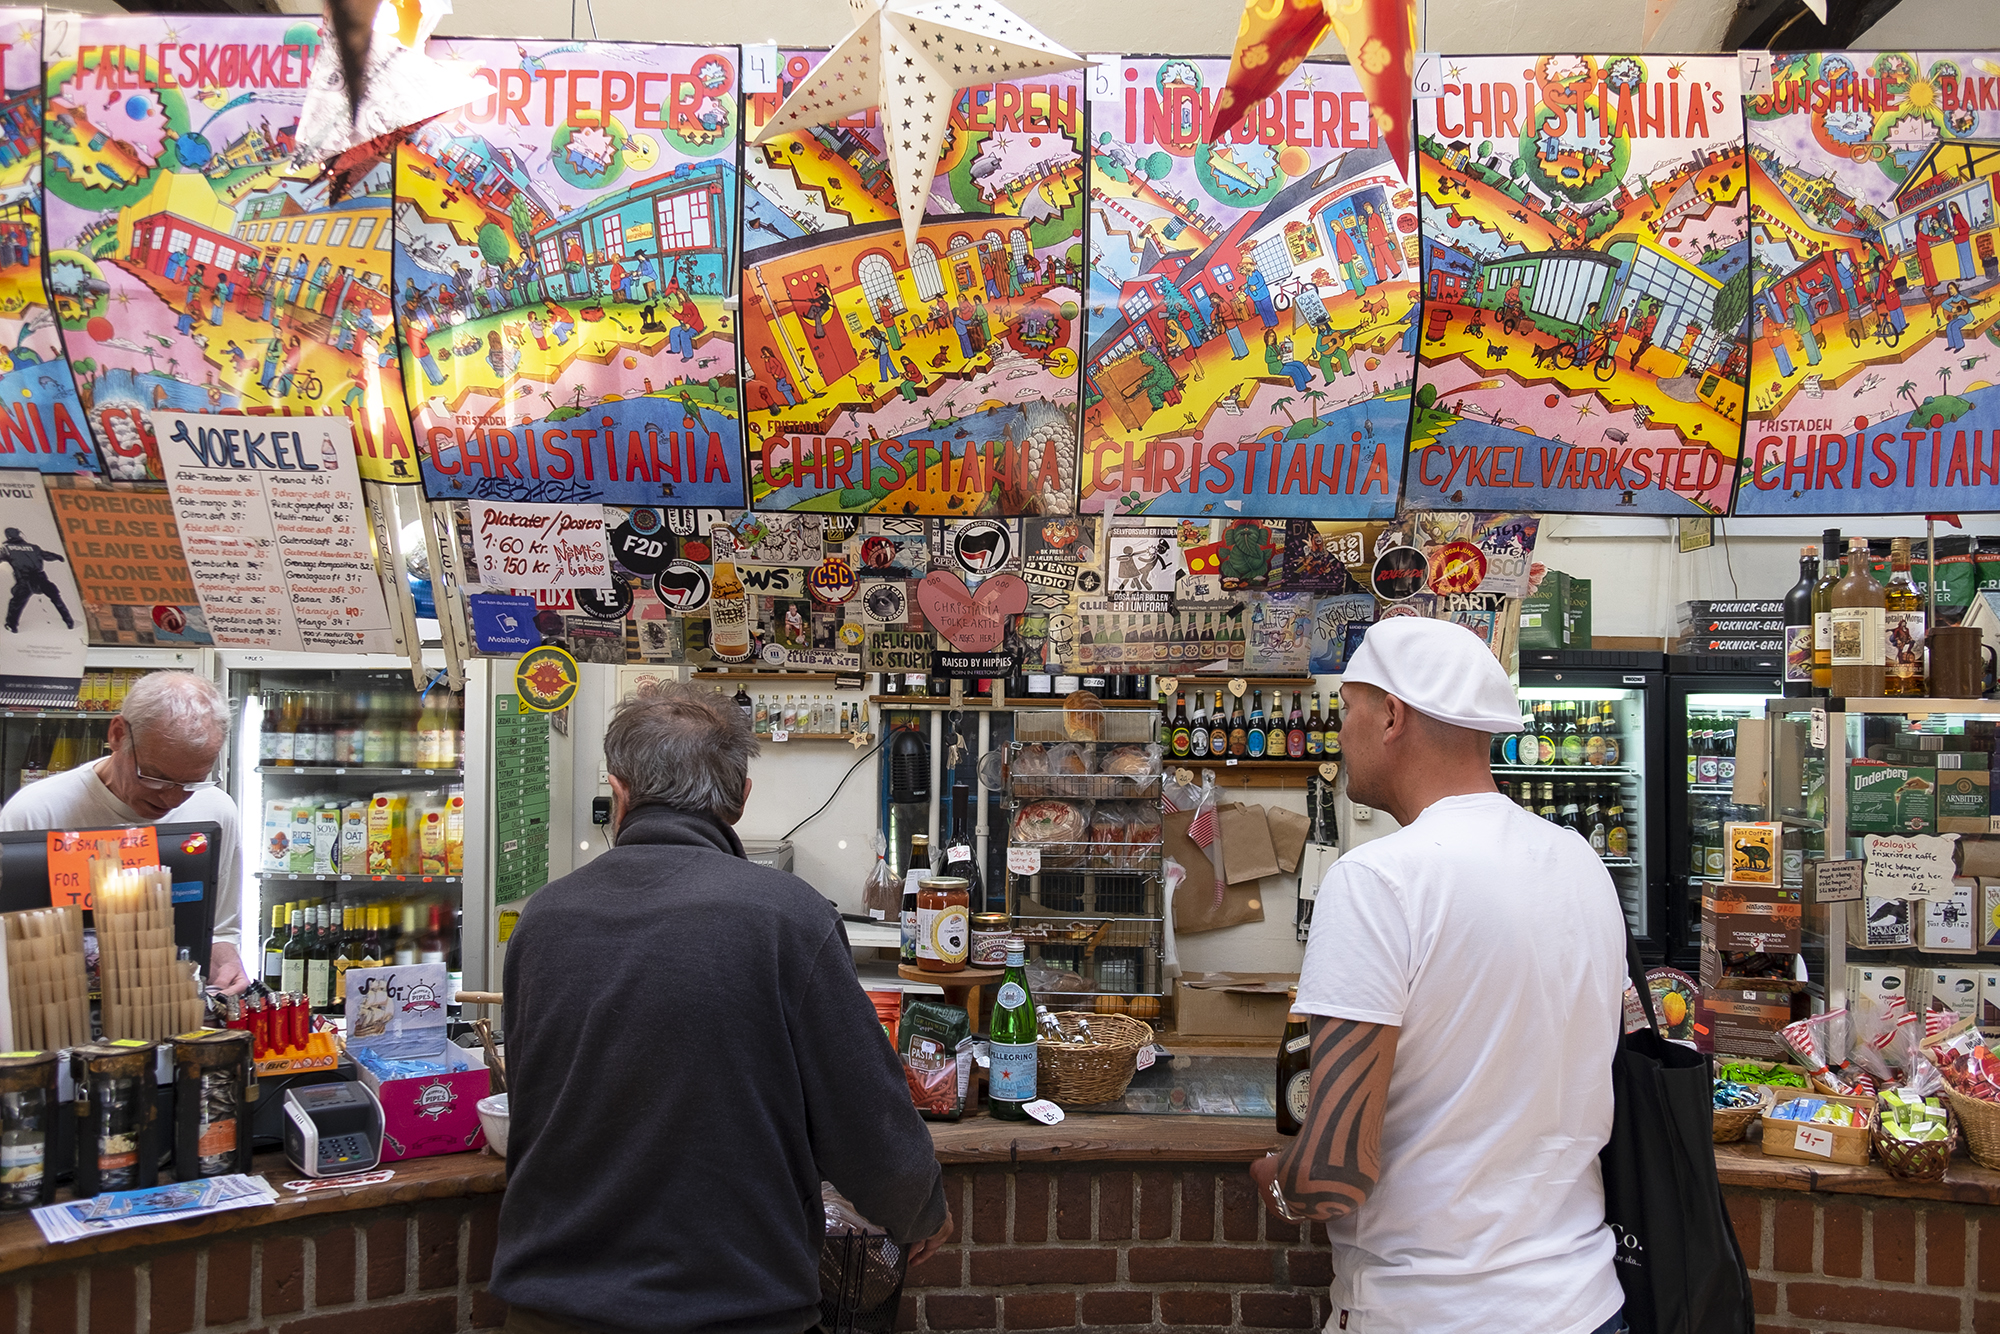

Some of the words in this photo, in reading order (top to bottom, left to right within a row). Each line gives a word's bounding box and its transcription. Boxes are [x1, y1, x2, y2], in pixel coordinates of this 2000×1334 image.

[1414, 72, 1437, 94] 6.
[470, 68, 704, 131] ORTEPER
[1941, 77, 2000, 112] BAK
[1123, 67, 1379, 149] INDKØBERE
[1758, 418, 1833, 432] FRISTADEN
[170, 420, 319, 472] VOEKEL
[426, 415, 732, 483] CHRISTIANIA
[762, 436, 1062, 493] CHRISTIANIA
[1096, 430, 1390, 497] CHRISTIANIA
[58, 494, 173, 517] FOREIGNE
[1420, 512, 1470, 523] INVASIO
[66, 517, 159, 539] PLEASE
[72, 541, 148, 561] LEAVE
[152, 544, 185, 562] US
[499, 536, 525, 555] 60
[622, 534, 664, 558] F2D
[503, 556, 527, 576] 150
[933, 555, 960, 568] OPER
[83, 564, 161, 582] ALONE
[818, 564, 849, 585] CSC
[1022, 573, 1068, 589] RADIO
[88, 585, 135, 604] THE
[1450, 592, 1507, 612] PARTY
[1113, 602, 1124, 612] ER
[1131, 602, 1168, 613] UNIFORM
[488, 635, 530, 646] MobilePay
[872, 632, 936, 650] RELIGION
[871, 651, 884, 667] IS
[887, 651, 933, 669] STUPID
[942, 657, 968, 668] RAISED
[970, 658, 981, 668] BY
[982, 656, 1012, 668] HIPPIES
[1853, 767, 1908, 791] Underberg
[1945, 794, 1984, 804] ARNBITTER
[316, 823, 339, 834] SOYA
[344, 830, 364, 841] OAT
[1733, 828, 1748, 836] Just
[1748, 829, 1772, 837] Coffee
[1872, 839, 1919, 852] Økologisk
[54, 872, 79, 887] FOR
[911, 1049, 933, 1061] PASTA
[1799, 1130, 1825, 1147] 4,-
